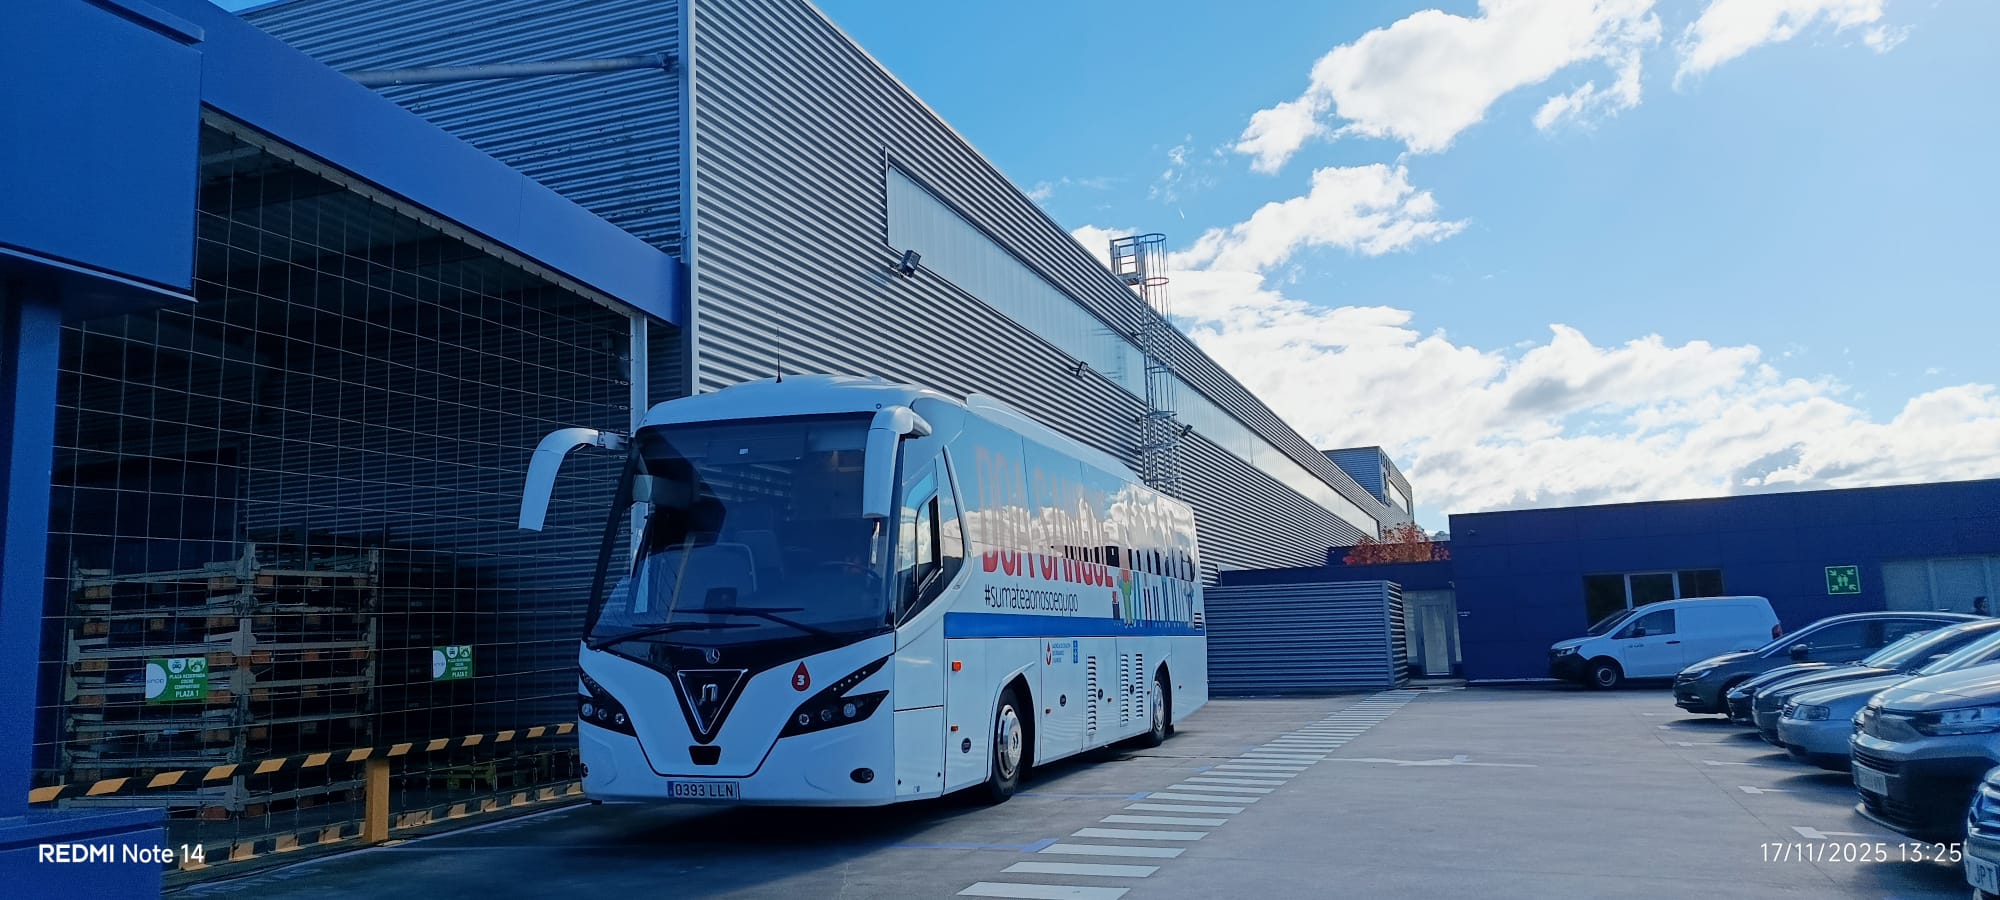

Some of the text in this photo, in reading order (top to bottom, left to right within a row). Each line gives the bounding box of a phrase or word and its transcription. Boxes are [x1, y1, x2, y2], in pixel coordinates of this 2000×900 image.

[797, 674, 805, 686] 3
[675, 784, 734, 797] 0393 LLN
